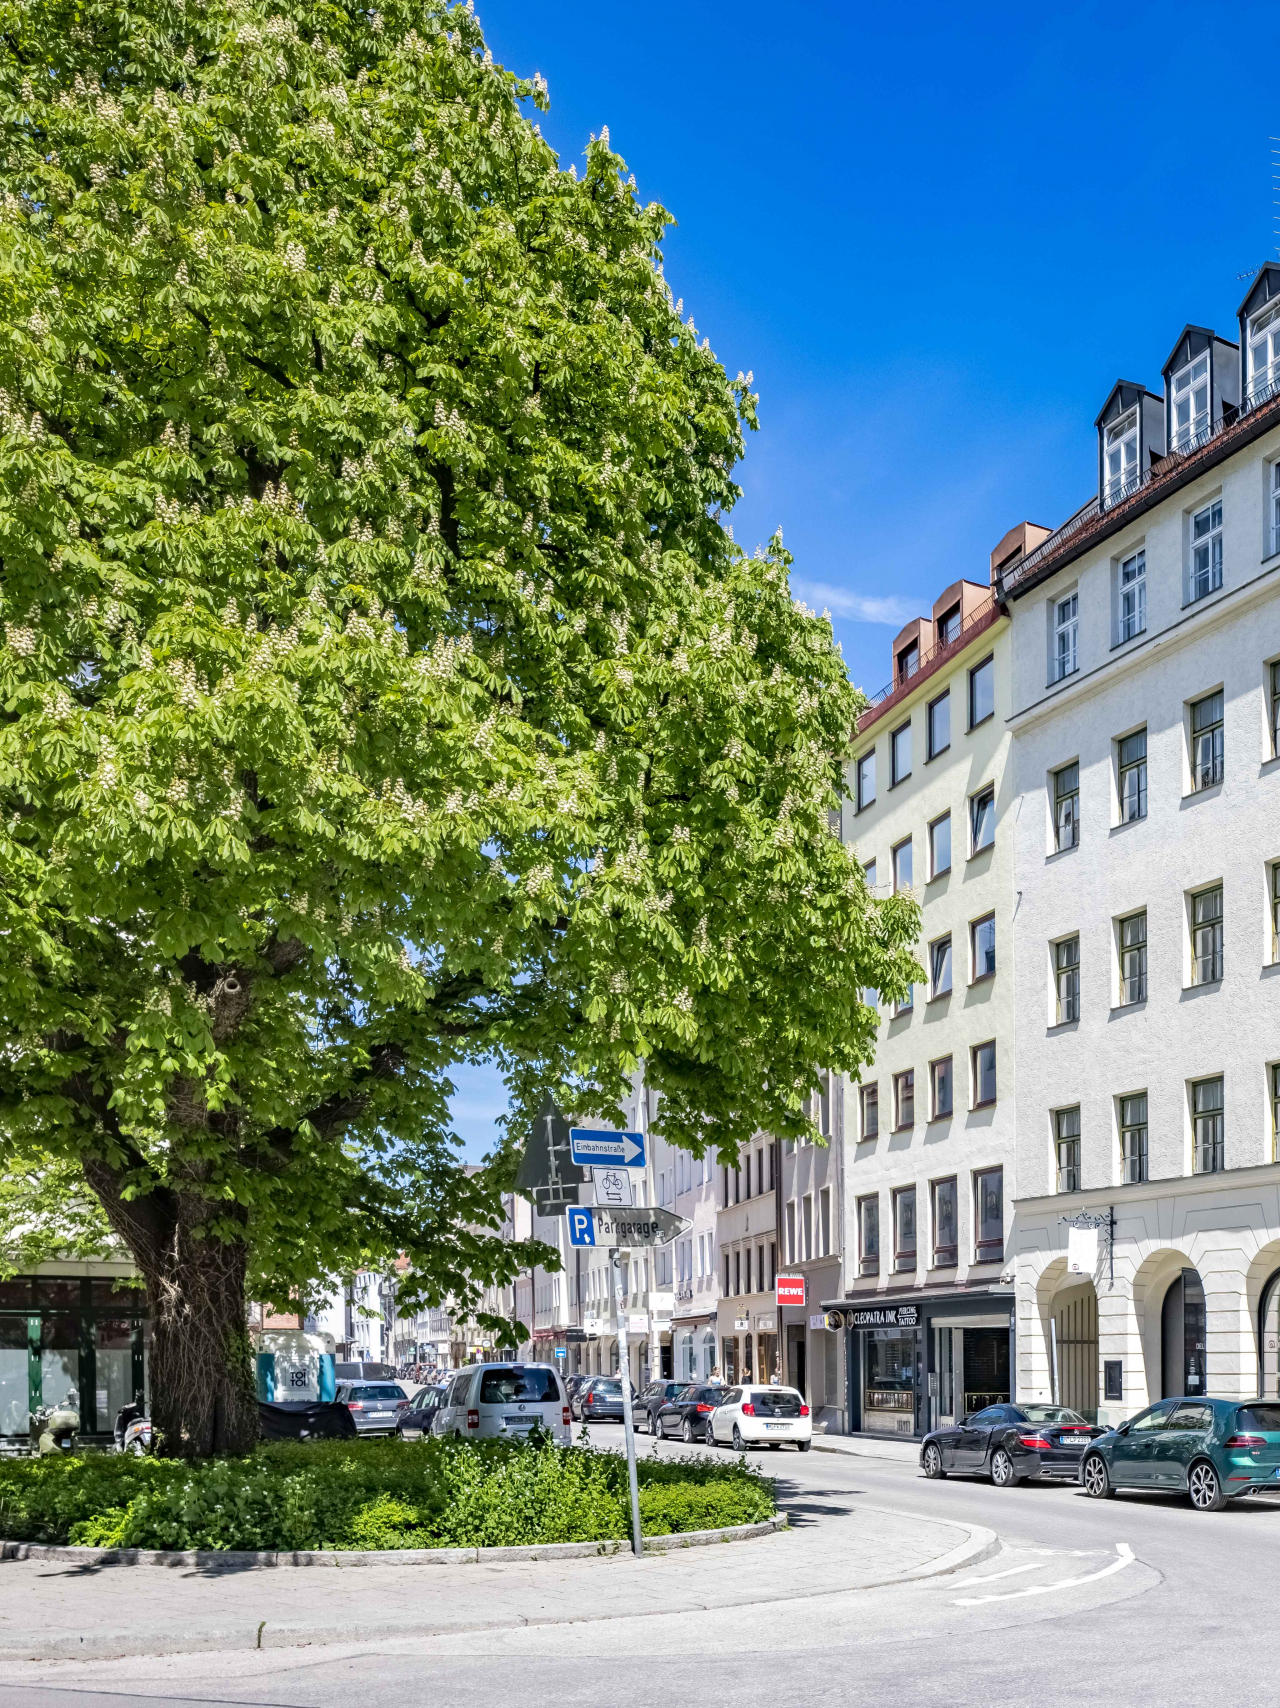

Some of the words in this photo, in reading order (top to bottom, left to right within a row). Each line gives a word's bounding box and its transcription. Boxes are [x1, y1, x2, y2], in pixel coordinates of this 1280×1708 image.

[576, 1142, 625, 1154] Einbahnstraße
[574, 1214, 587, 1239] P
[598, 1217, 659, 1239] Parkgarage
[778, 1287, 804, 1295] REWE
[899, 1306, 916, 1314] PIERCING
[854, 1310, 885, 1324] CLEOPATRA
[886, 1310, 897, 1323] INK
[899, 1317, 916, 1325] TATTOO
